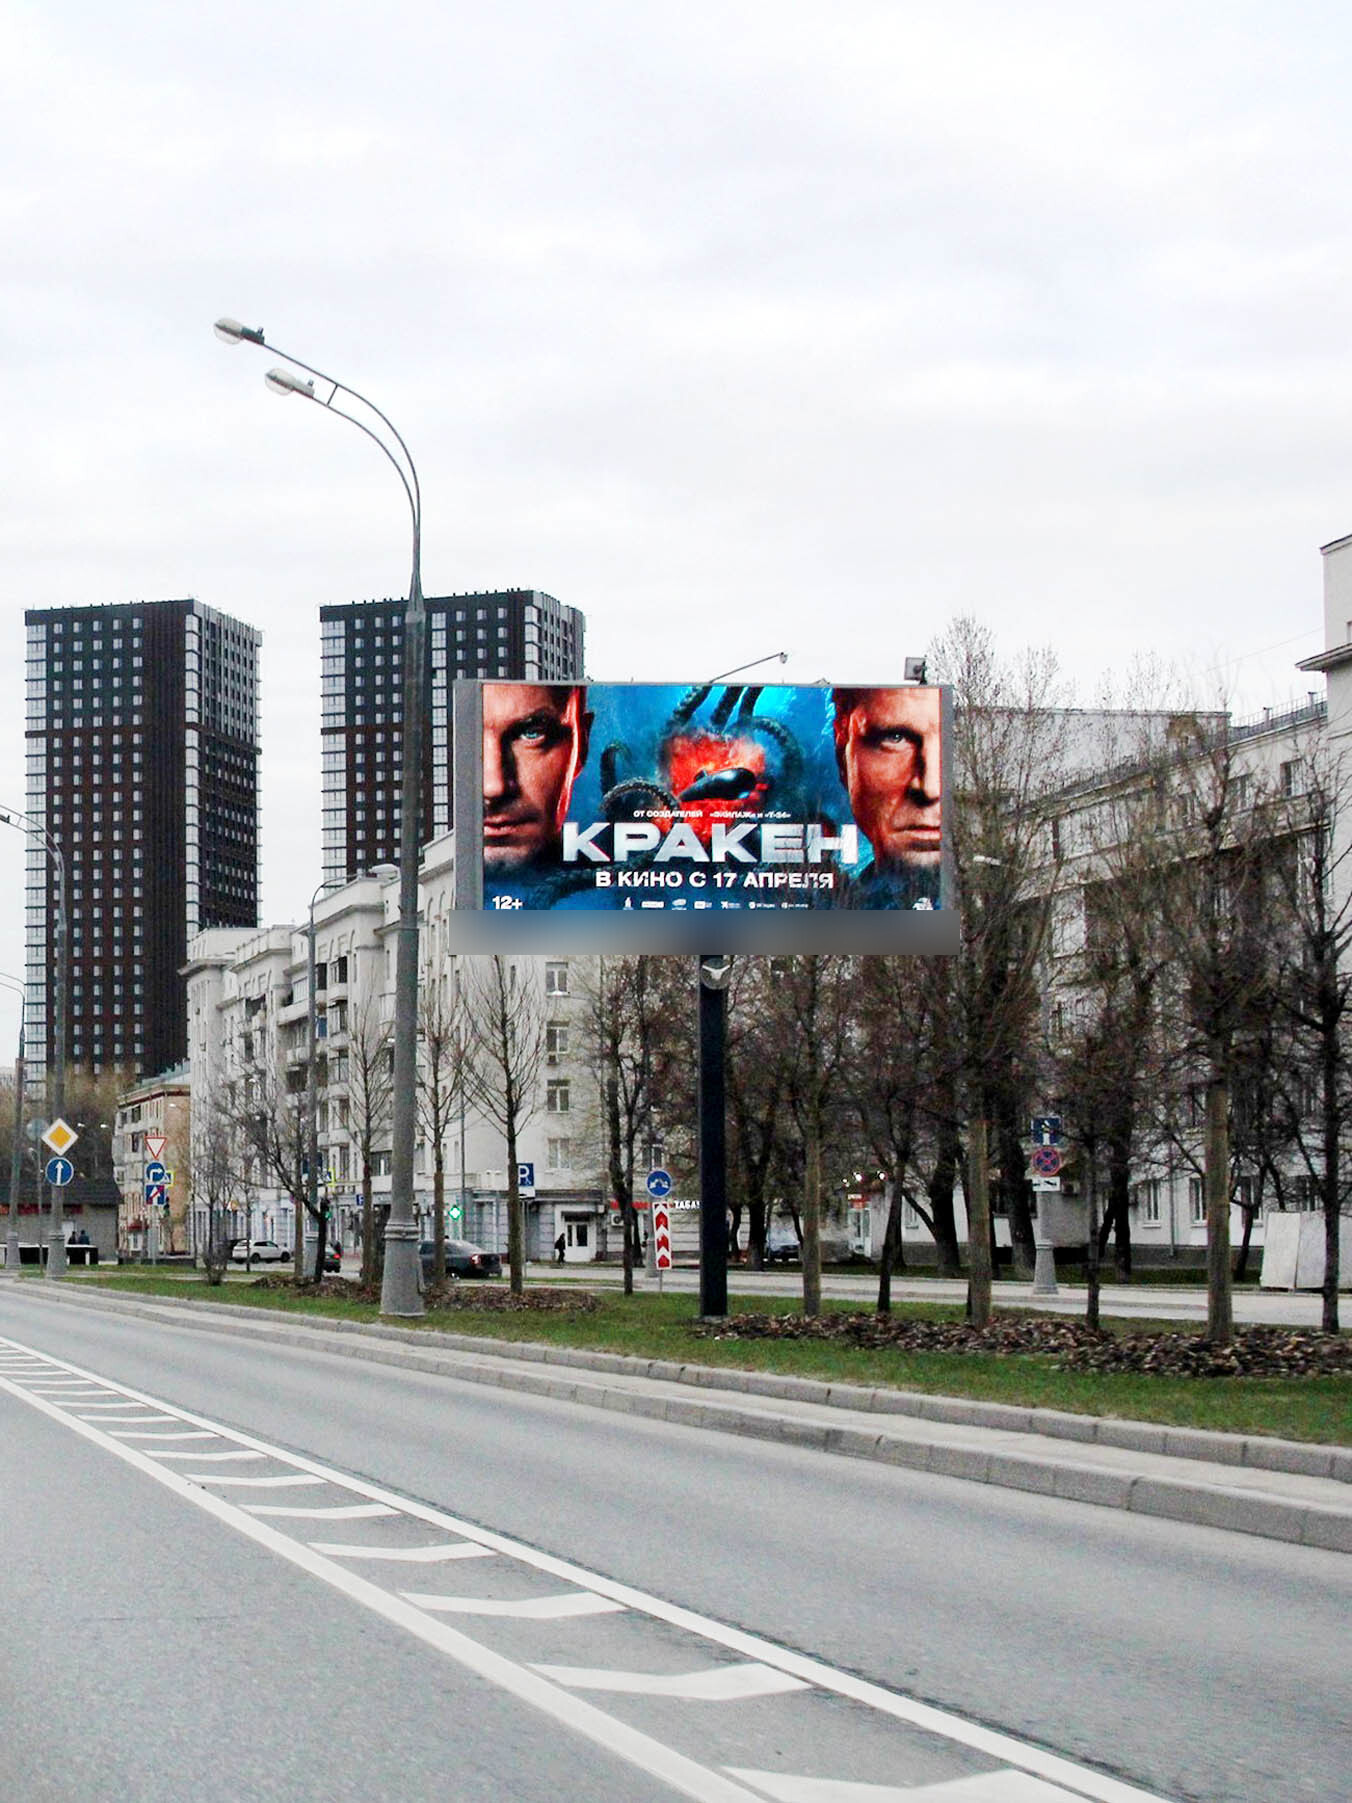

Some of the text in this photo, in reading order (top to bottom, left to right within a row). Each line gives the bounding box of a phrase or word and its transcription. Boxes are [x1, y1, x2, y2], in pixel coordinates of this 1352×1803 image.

[563, 823, 858, 864] КРАКЕН
[596, 872, 834, 889] В КИНО С 17 АПРЕЛЯ
[492, 896, 524, 910] 12+
